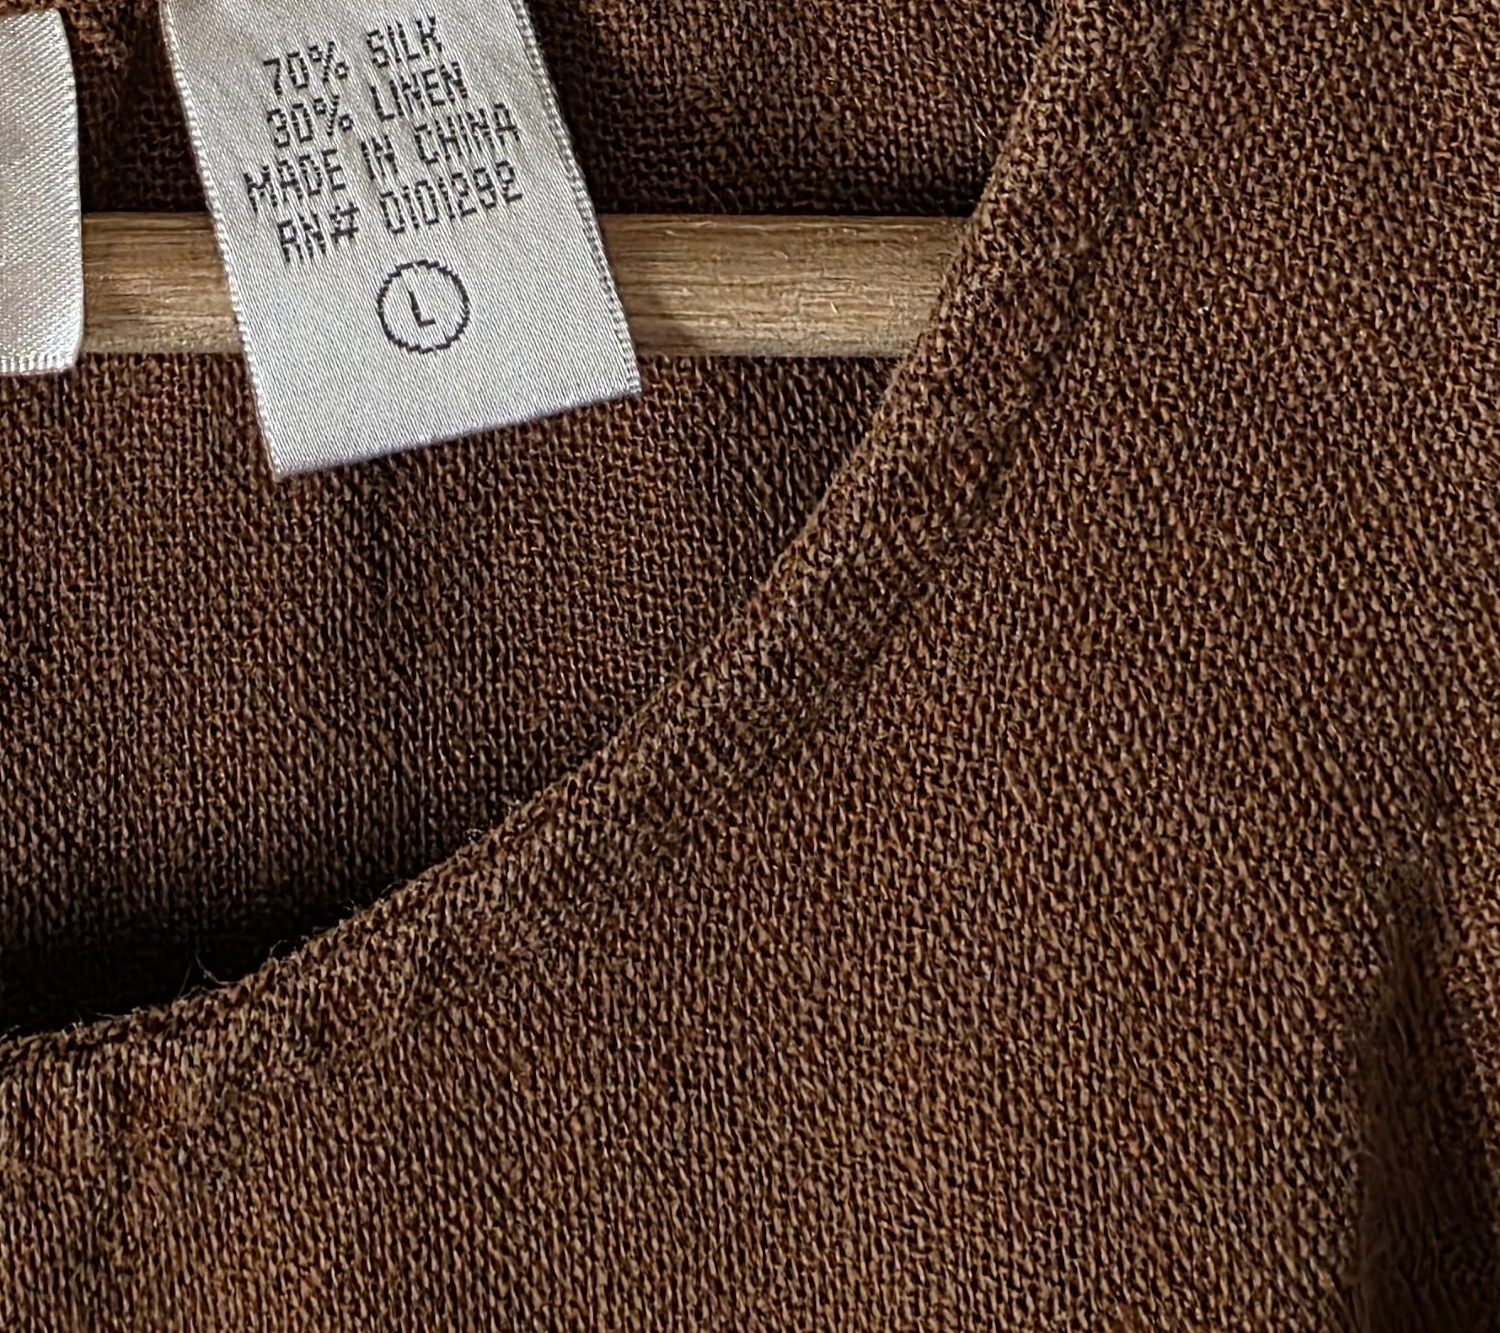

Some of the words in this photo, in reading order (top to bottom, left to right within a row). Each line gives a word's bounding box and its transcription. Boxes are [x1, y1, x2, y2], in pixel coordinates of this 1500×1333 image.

[263, 41, 350, 96] 70%
[367, 15, 443, 68] SILK
[267, 95, 354, 148] 30%
[370, 61, 468, 122] LINEN
[243, 149, 346, 212] MADE
[361, 134, 399, 180] IN
[415, 103, 520, 165] CHINA
[277, 203, 360, 263] RN#
[407, 288, 436, 327] L
